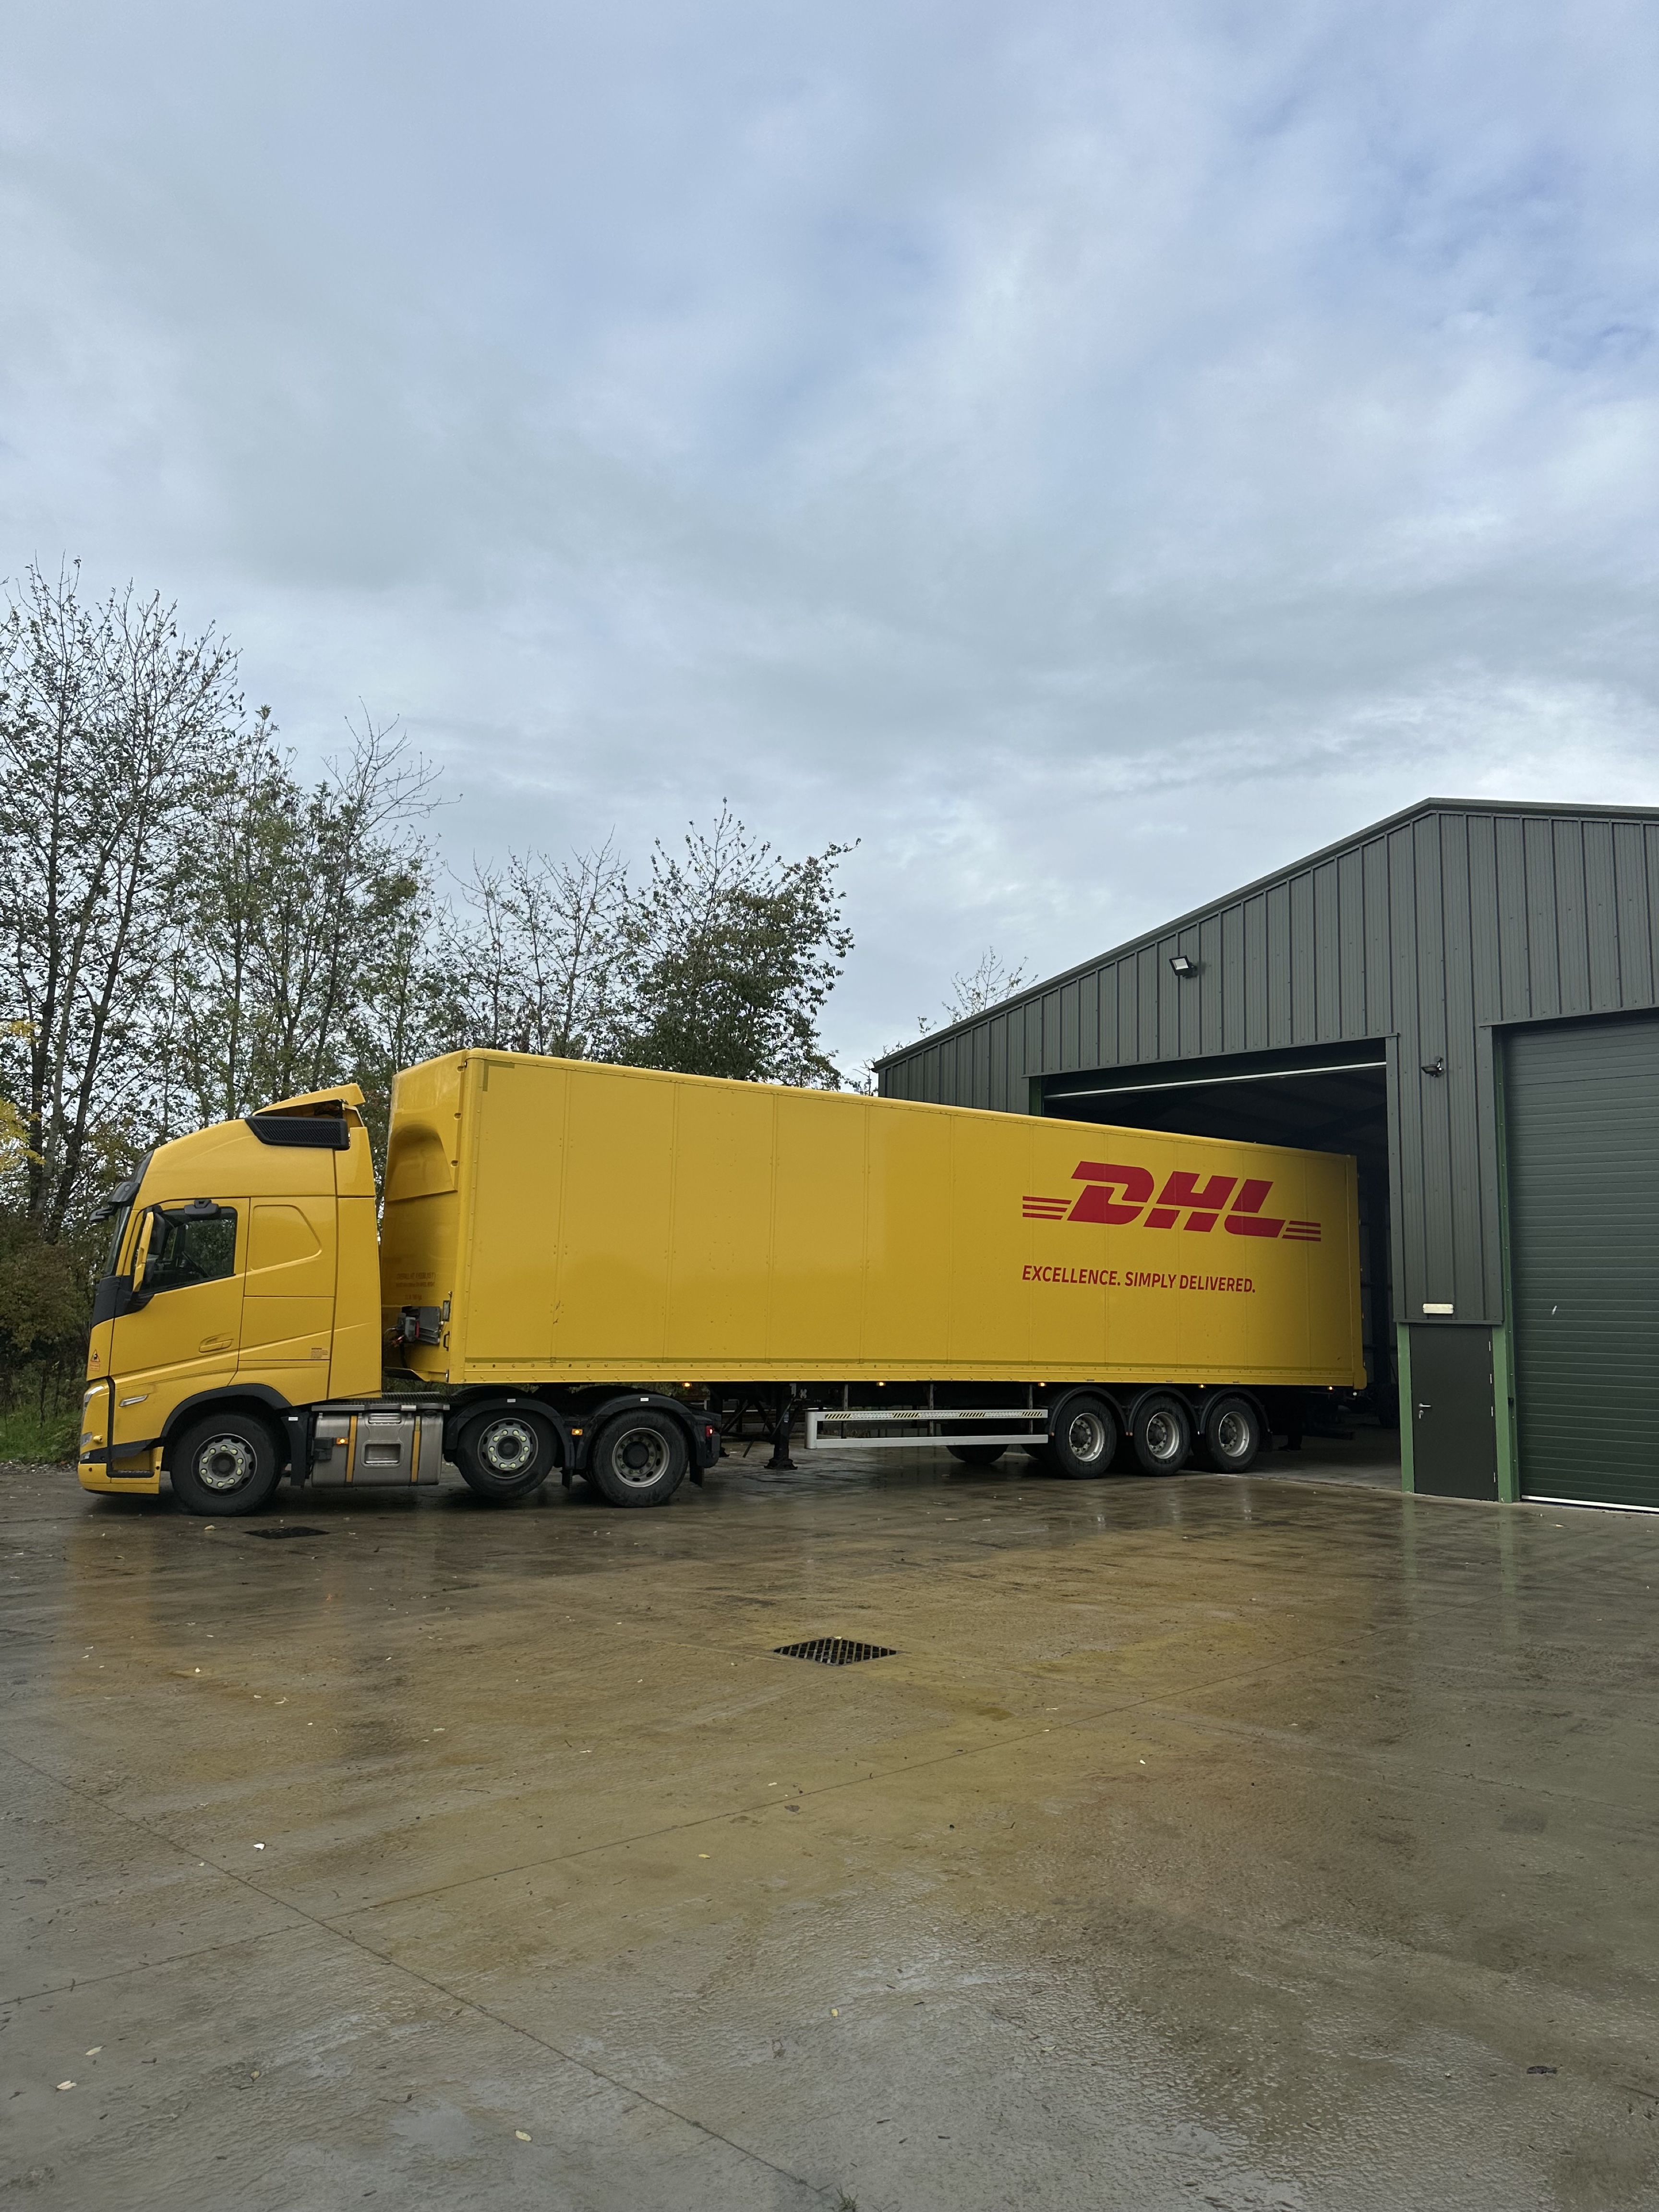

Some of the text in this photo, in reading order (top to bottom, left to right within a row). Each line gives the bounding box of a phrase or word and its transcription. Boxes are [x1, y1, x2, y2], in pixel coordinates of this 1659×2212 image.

[1066, 1160, 1286, 1238] DHL
[1022, 1264, 1256, 1293] EXCELLENCE. SIMPLY DELIVERED.
